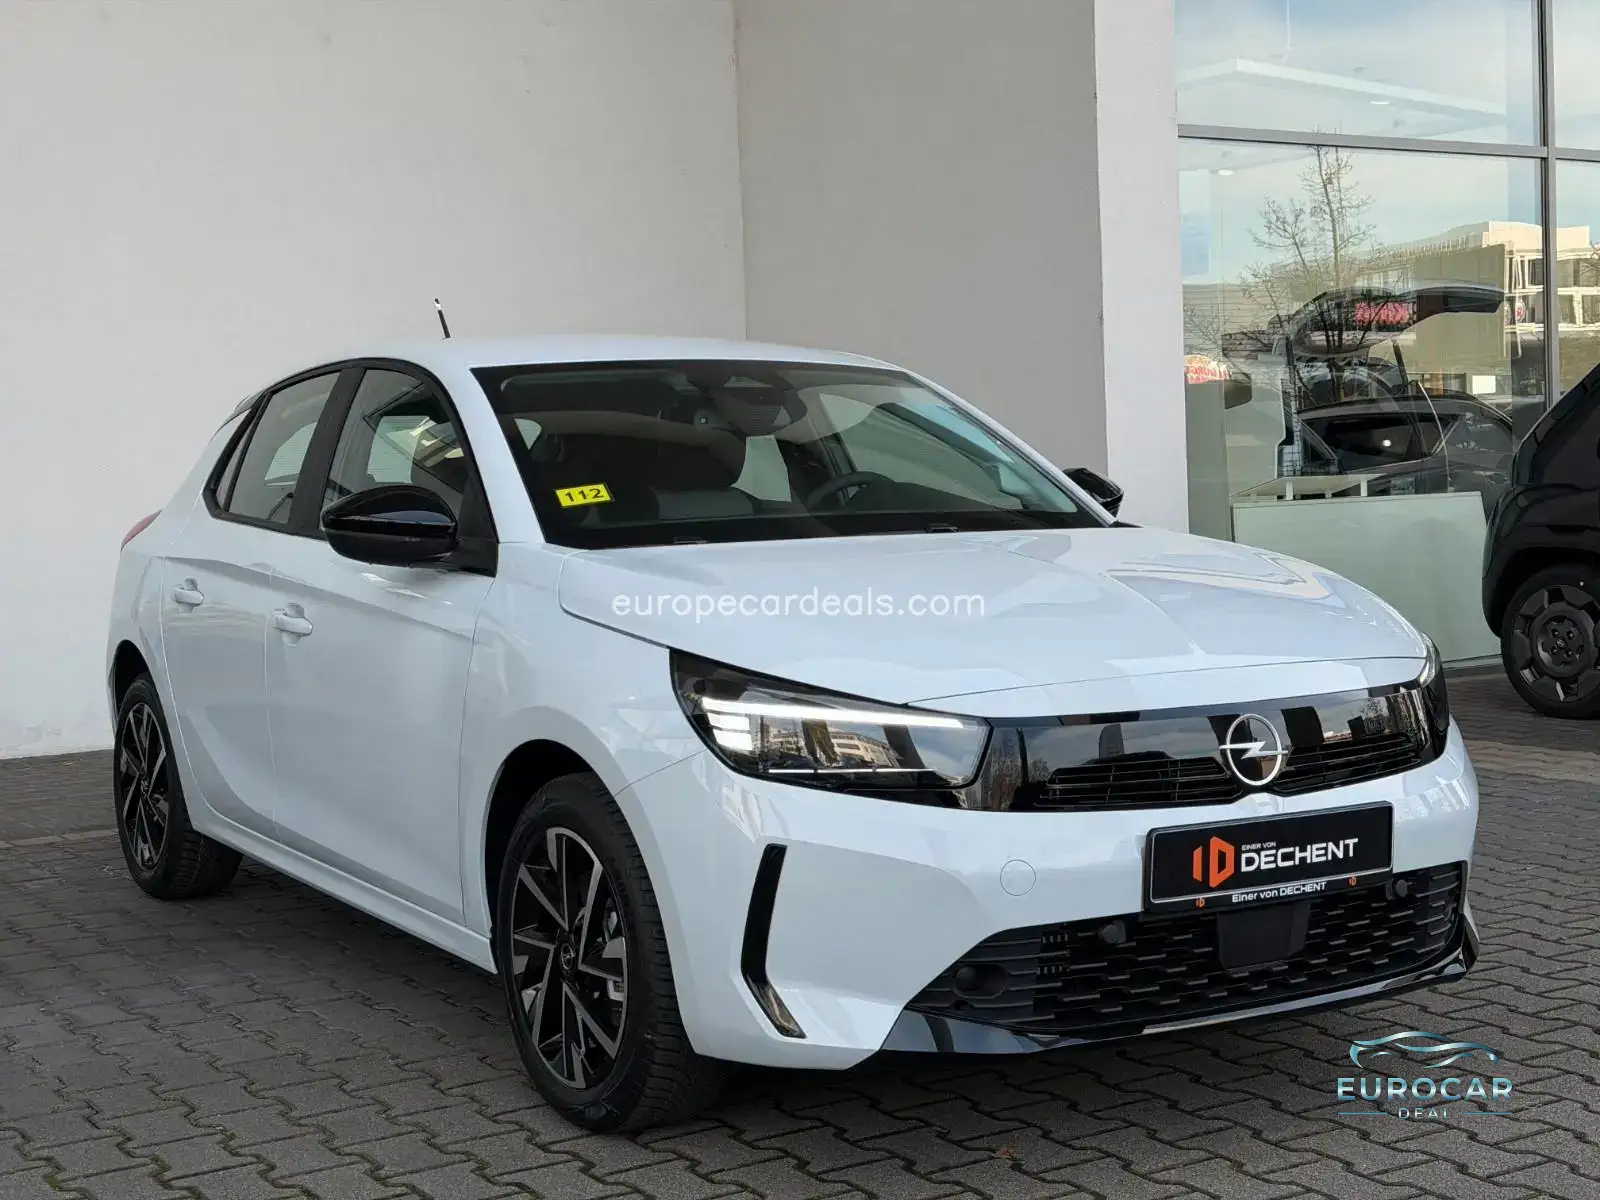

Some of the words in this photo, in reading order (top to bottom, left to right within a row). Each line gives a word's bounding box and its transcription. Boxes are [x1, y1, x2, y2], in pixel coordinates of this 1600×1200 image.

[565, 488, 604, 502] 112
[1241, 842, 1262, 851] EINER
[1262, 841, 1277, 849] VON
[1241, 838, 1359, 872] DECHENT
[1232, 892, 1258, 903] Einer
[1259, 889, 1278, 900] von
[1279, 882, 1327, 897] DECHENT
